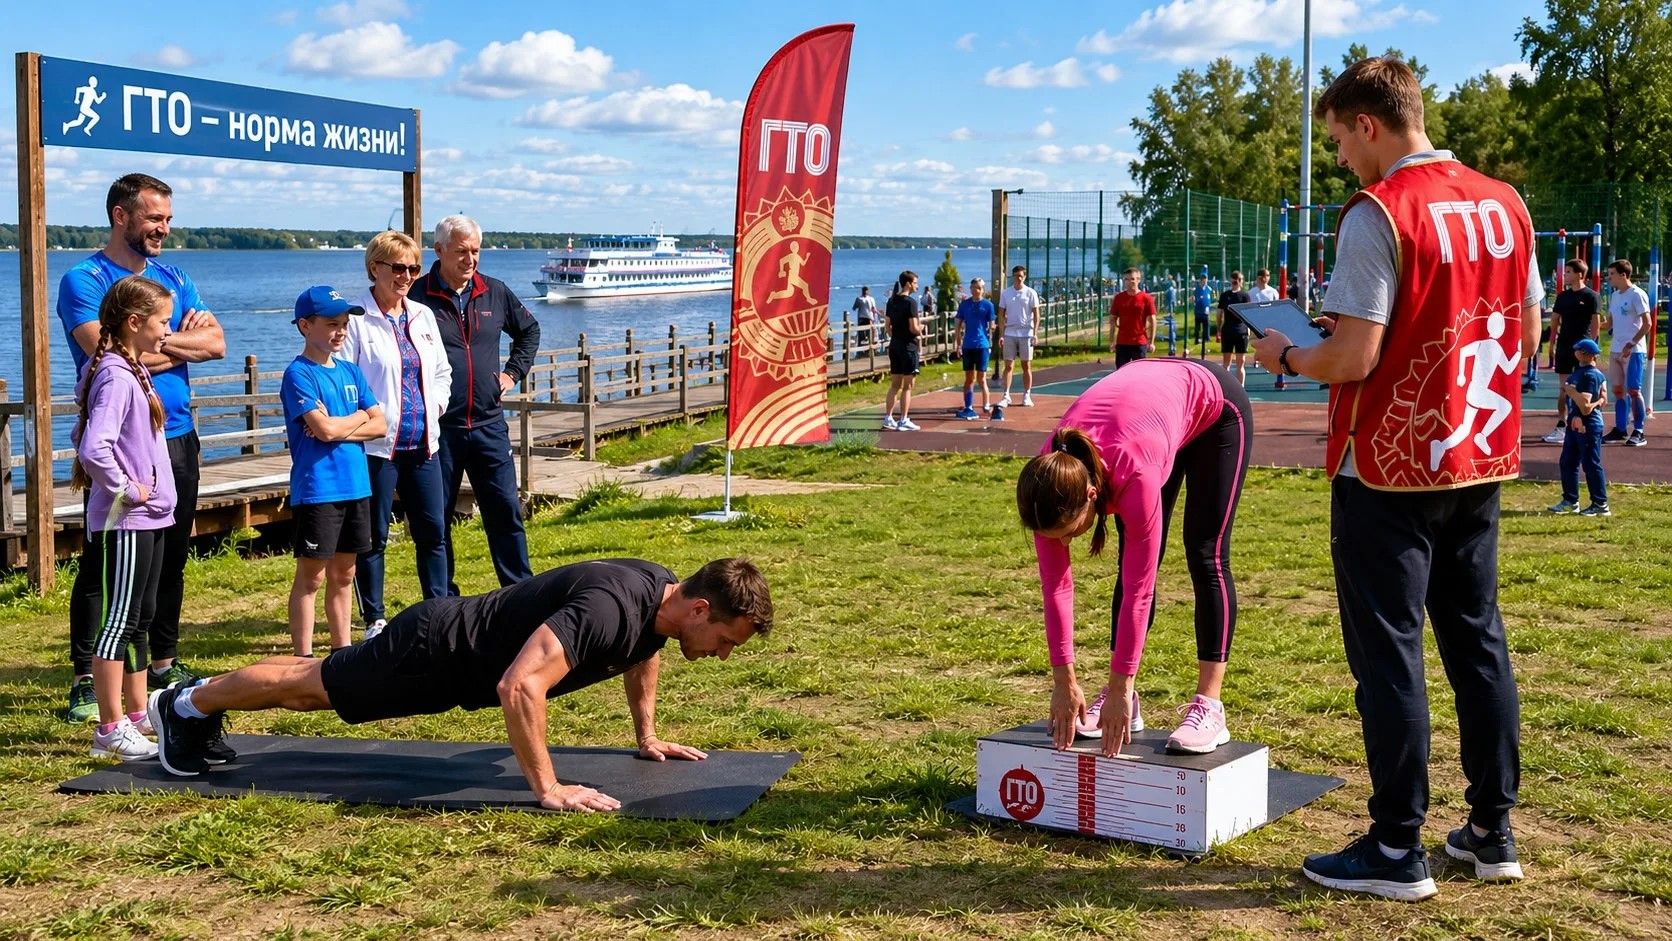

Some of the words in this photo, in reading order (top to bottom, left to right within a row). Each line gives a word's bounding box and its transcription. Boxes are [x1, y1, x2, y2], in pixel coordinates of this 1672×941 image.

[122, 84, 192, 136] ГТО
[229, 111, 316, 152] норма
[322, 122, 406, 156] жизни!
[759, 118, 831, 176] ГТО
[1427, 198, 1515, 264] ГТО
[1006, 777, 1037, 805] ГТО
[1176, 785, 1186, 796] 10
